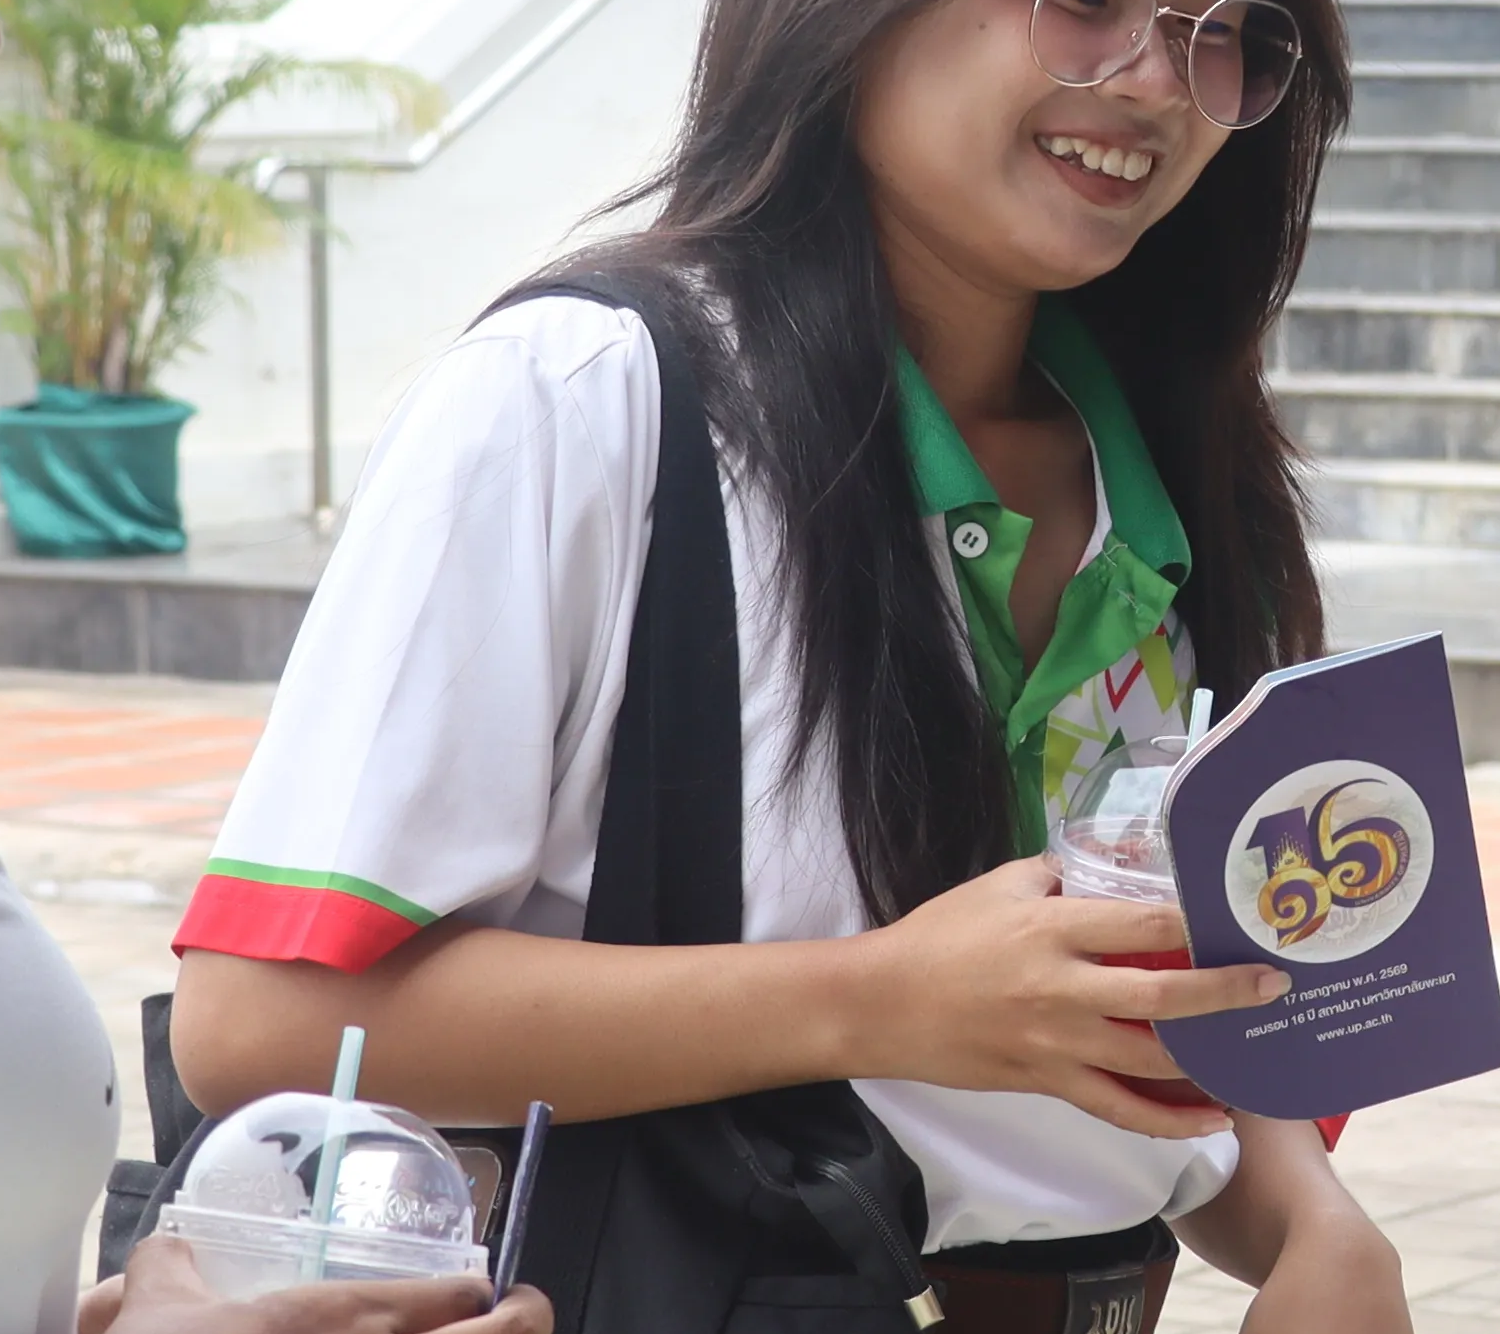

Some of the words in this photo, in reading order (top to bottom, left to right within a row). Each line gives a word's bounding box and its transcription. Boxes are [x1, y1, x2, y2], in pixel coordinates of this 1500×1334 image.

[1245, 1019, 1289, 1040] ครบรอบ
[1290, 1012, 1306, 1026] 16
[1306, 1007, 1317, 1022] ปี
[1317, 997, 1361, 1019] สถาปนา
[1361, 971, 1456, 1006] มหาวิทยาลัยพะเยา
[1283, 993, 1297, 1007] 17
[1299, 980, 1351, 1002] กรกฎาคม
[1352, 973, 1377, 989] พ.ศ.
[1379, 963, 1408, 980] 2569
[1315, 1012, 1393, 1042] www.up.ac.th
